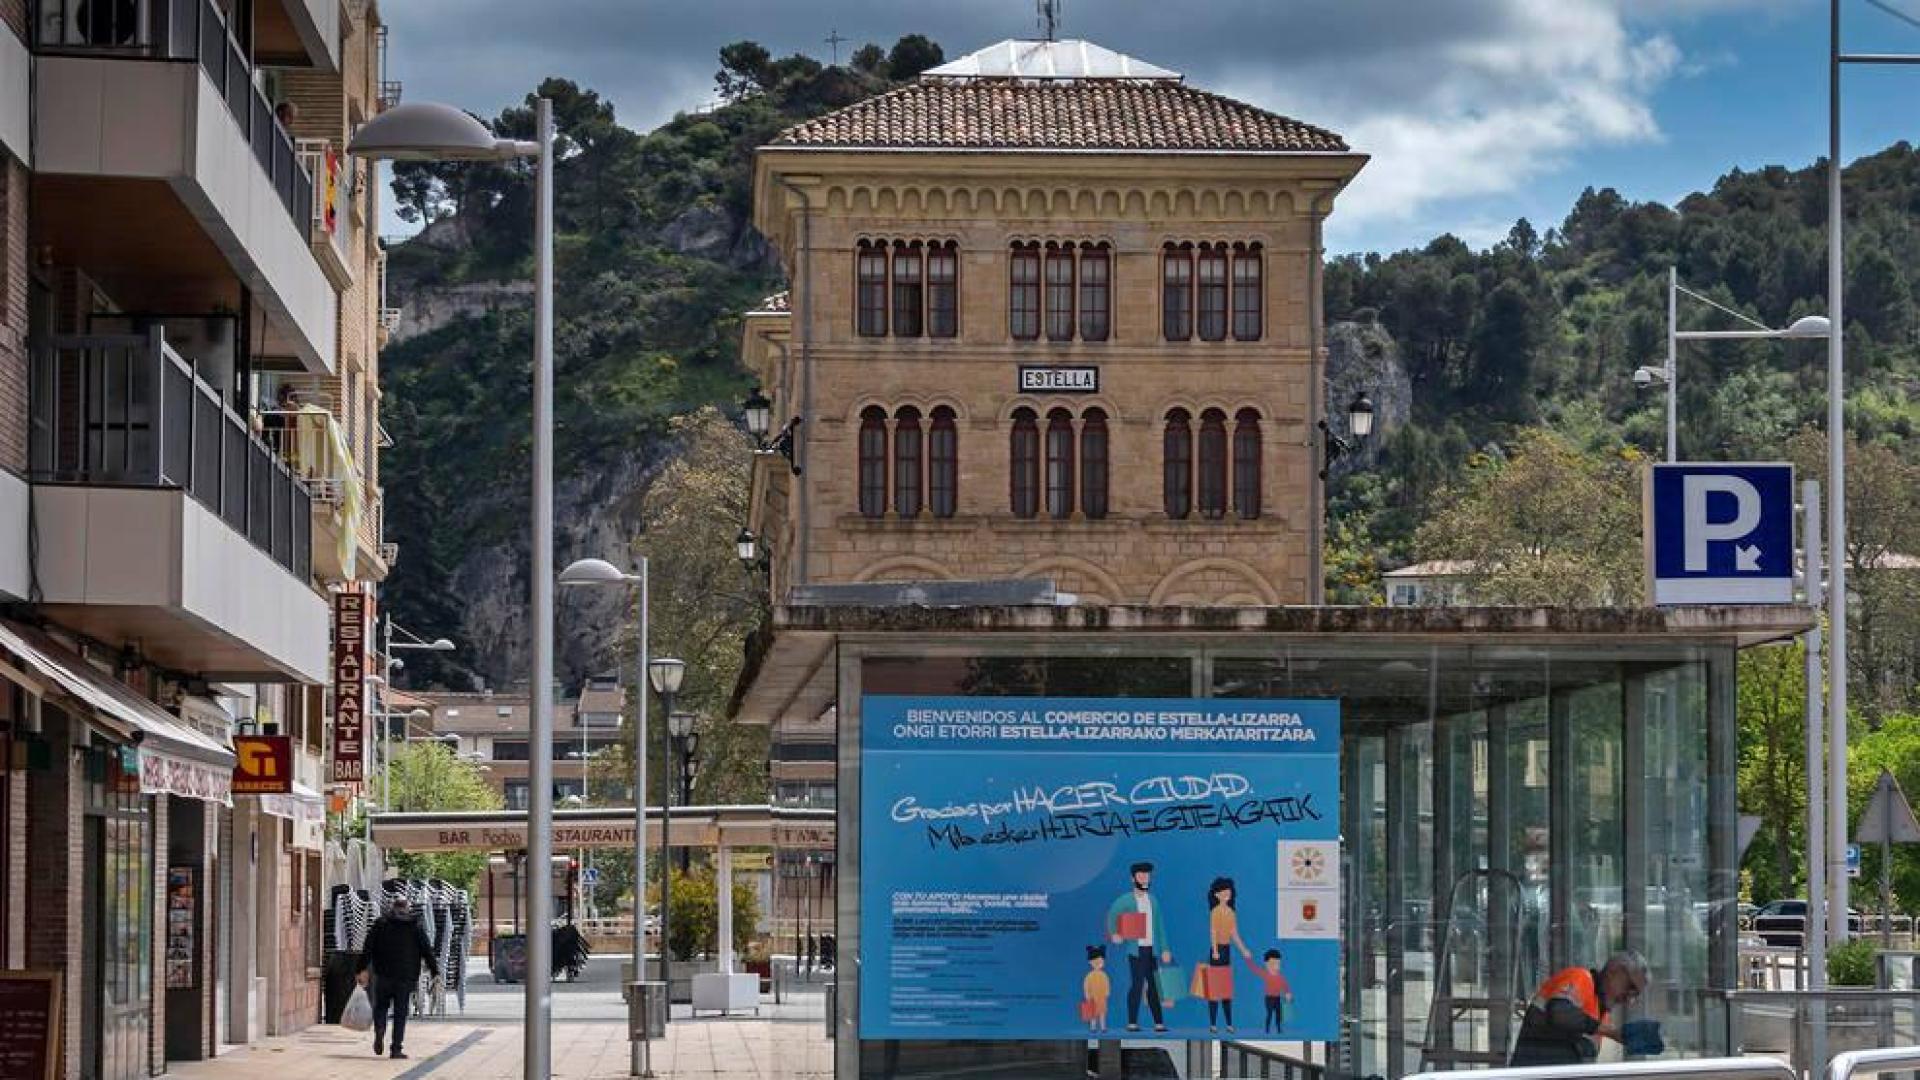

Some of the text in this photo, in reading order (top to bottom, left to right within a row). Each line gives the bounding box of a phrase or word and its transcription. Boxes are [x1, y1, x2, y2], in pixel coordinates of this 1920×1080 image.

[1025, 371, 1091, 387] ESTELLA
[1683, 474, 1761, 572] P
[338, 596, 361, 753] RESTAURANTE
[906, 709, 1303, 726] BIENVENIDOS AL COMERCIO DE ESTELLA-LIZARRA
[893, 725, 1316, 742] ONGI ETORRI ESTELLA-LIZARRAKO MERKATARITZARA
[335, 758, 362, 780] BAR
[891, 795, 976, 823] Gracias
[978, 801, 1014, 825] por
[1013, 780, 1128, 815] HACER
[439, 831, 470, 844] BAR
[552, 829, 637, 842] STAURANT
